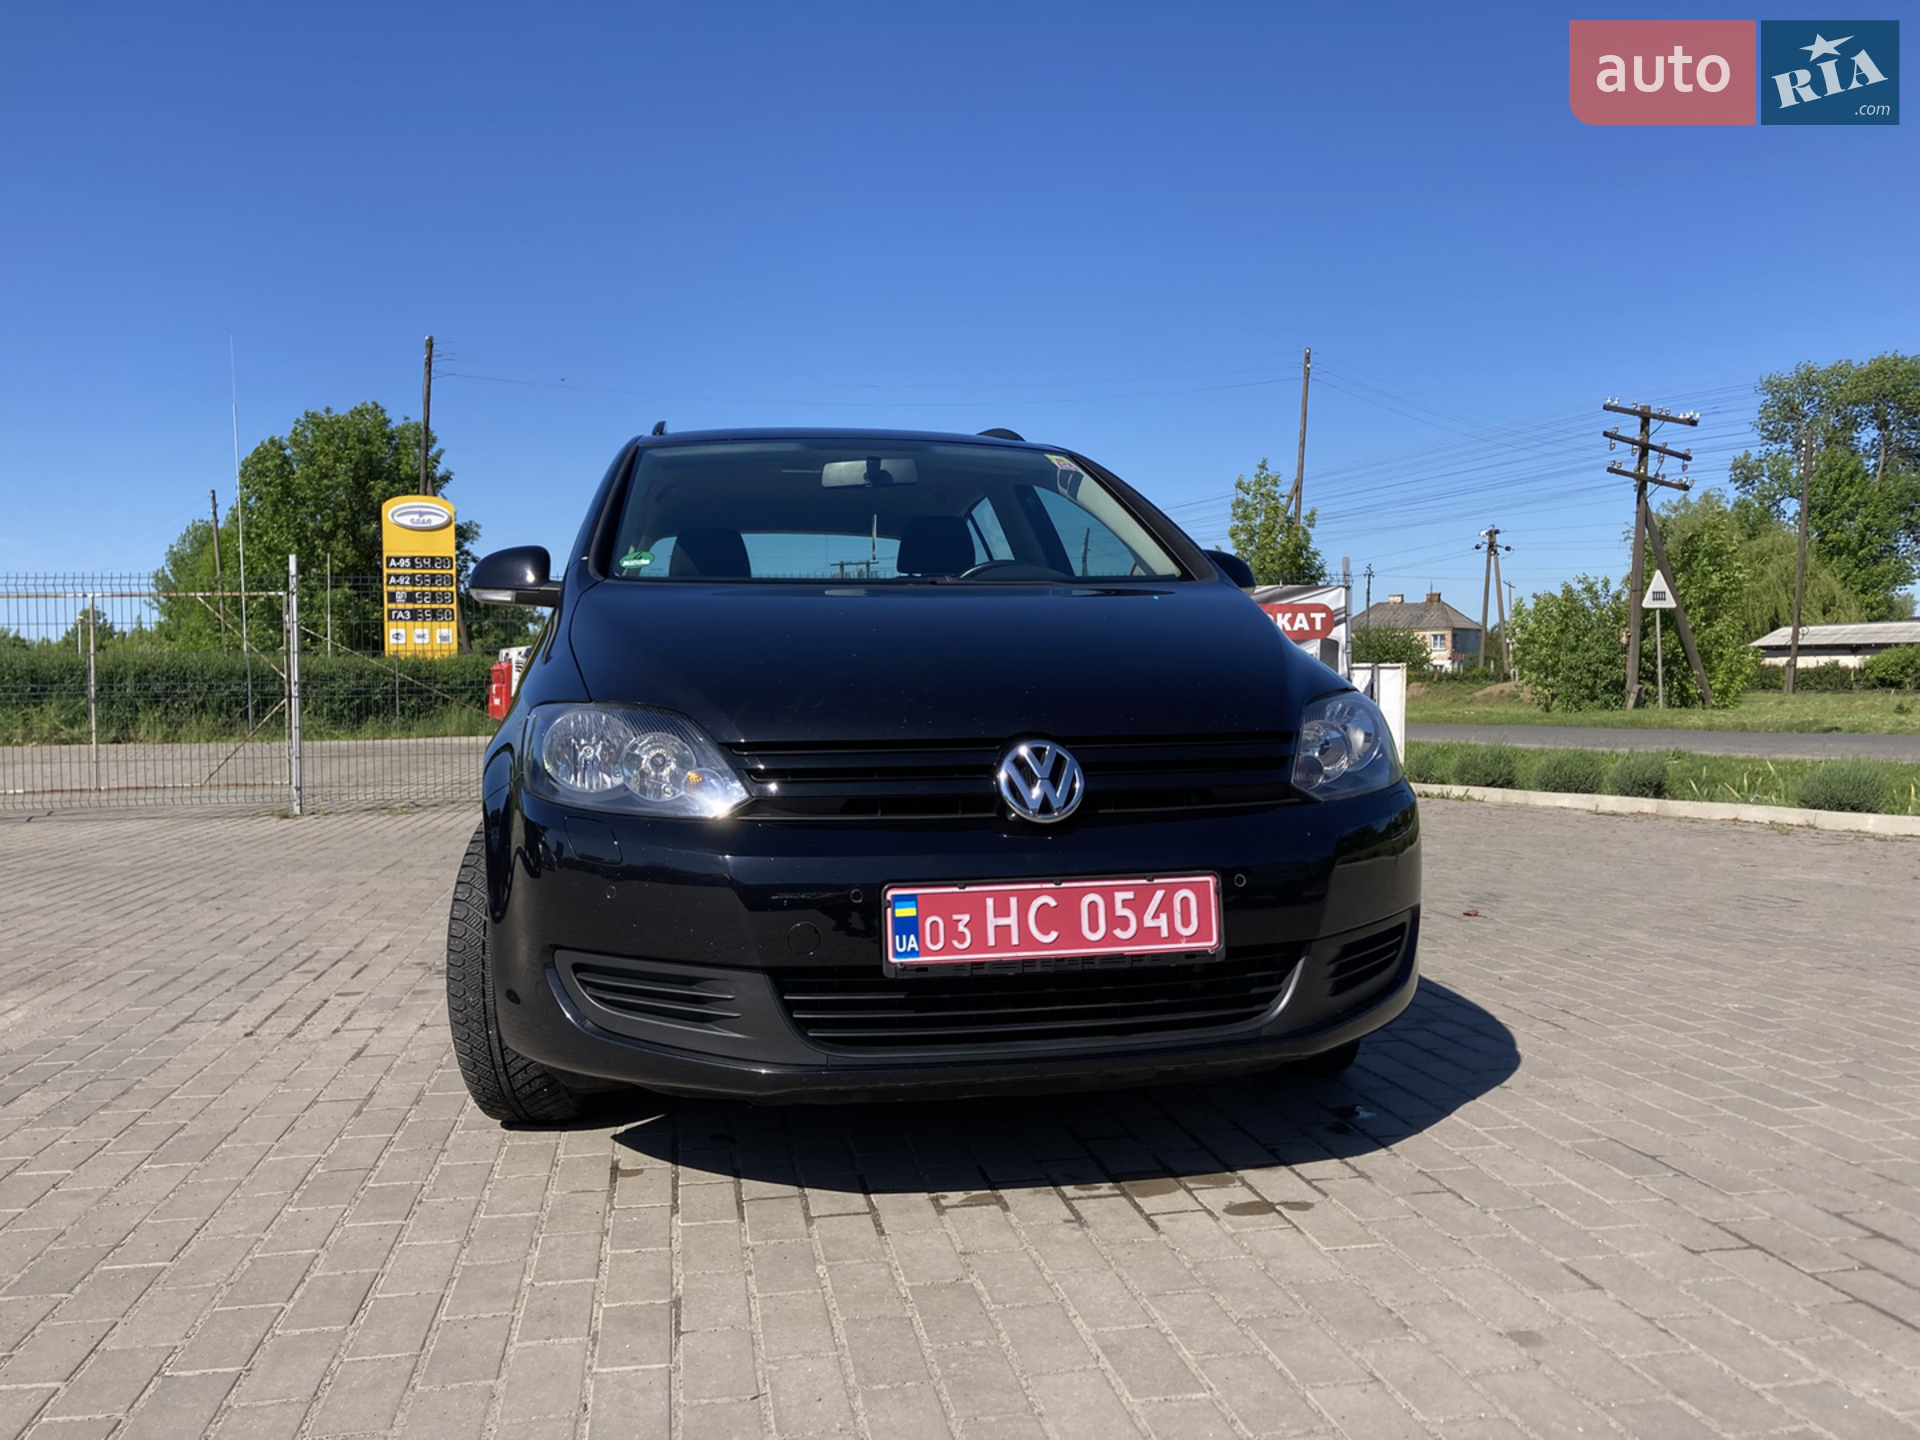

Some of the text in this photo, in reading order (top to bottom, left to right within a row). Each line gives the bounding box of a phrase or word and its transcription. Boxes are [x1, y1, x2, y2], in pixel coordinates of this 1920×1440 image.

[388, 558, 411, 568] А-95
[388, 575, 411, 585] А-92
[391, 610, 411, 620] ГАЗ
[1267, 612, 1326, 631] КАТ
[924, 888, 1199, 951] 03 HC 0540
[895, 934, 919, 953] UA
